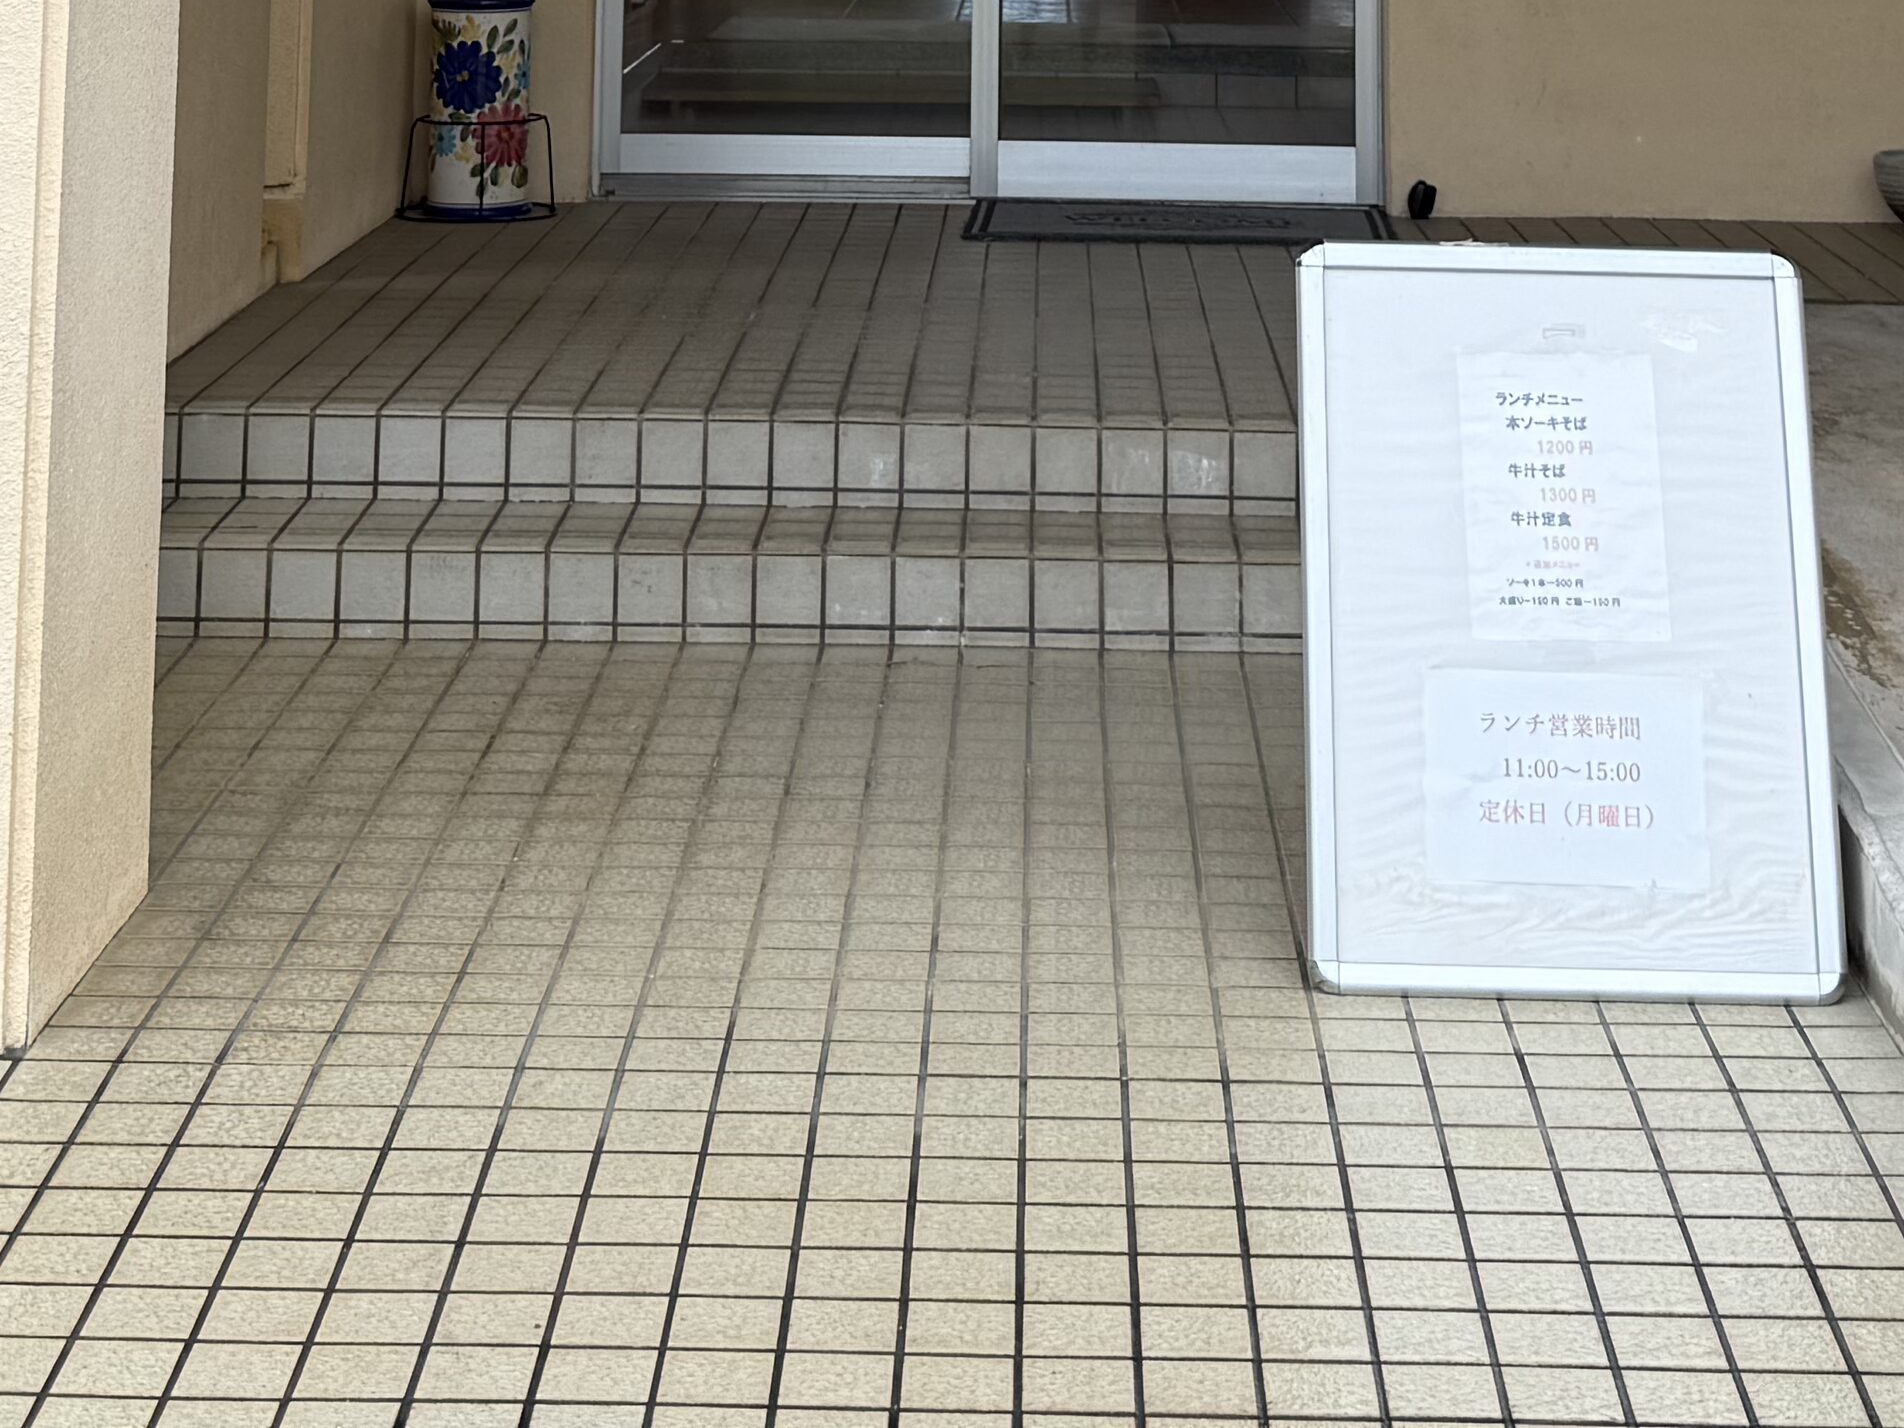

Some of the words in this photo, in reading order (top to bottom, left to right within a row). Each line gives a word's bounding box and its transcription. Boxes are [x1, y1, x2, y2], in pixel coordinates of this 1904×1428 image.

[1495, 391, 1584, 407] ランチメニュー
[1505, 415, 1588, 431] 本ソーキそば
[1508, 462, 1566, 479] 牛汁そば
[1510, 511, 1573, 528] 牛汁定食
[1479, 711, 1642, 741] ランチ営業時間
